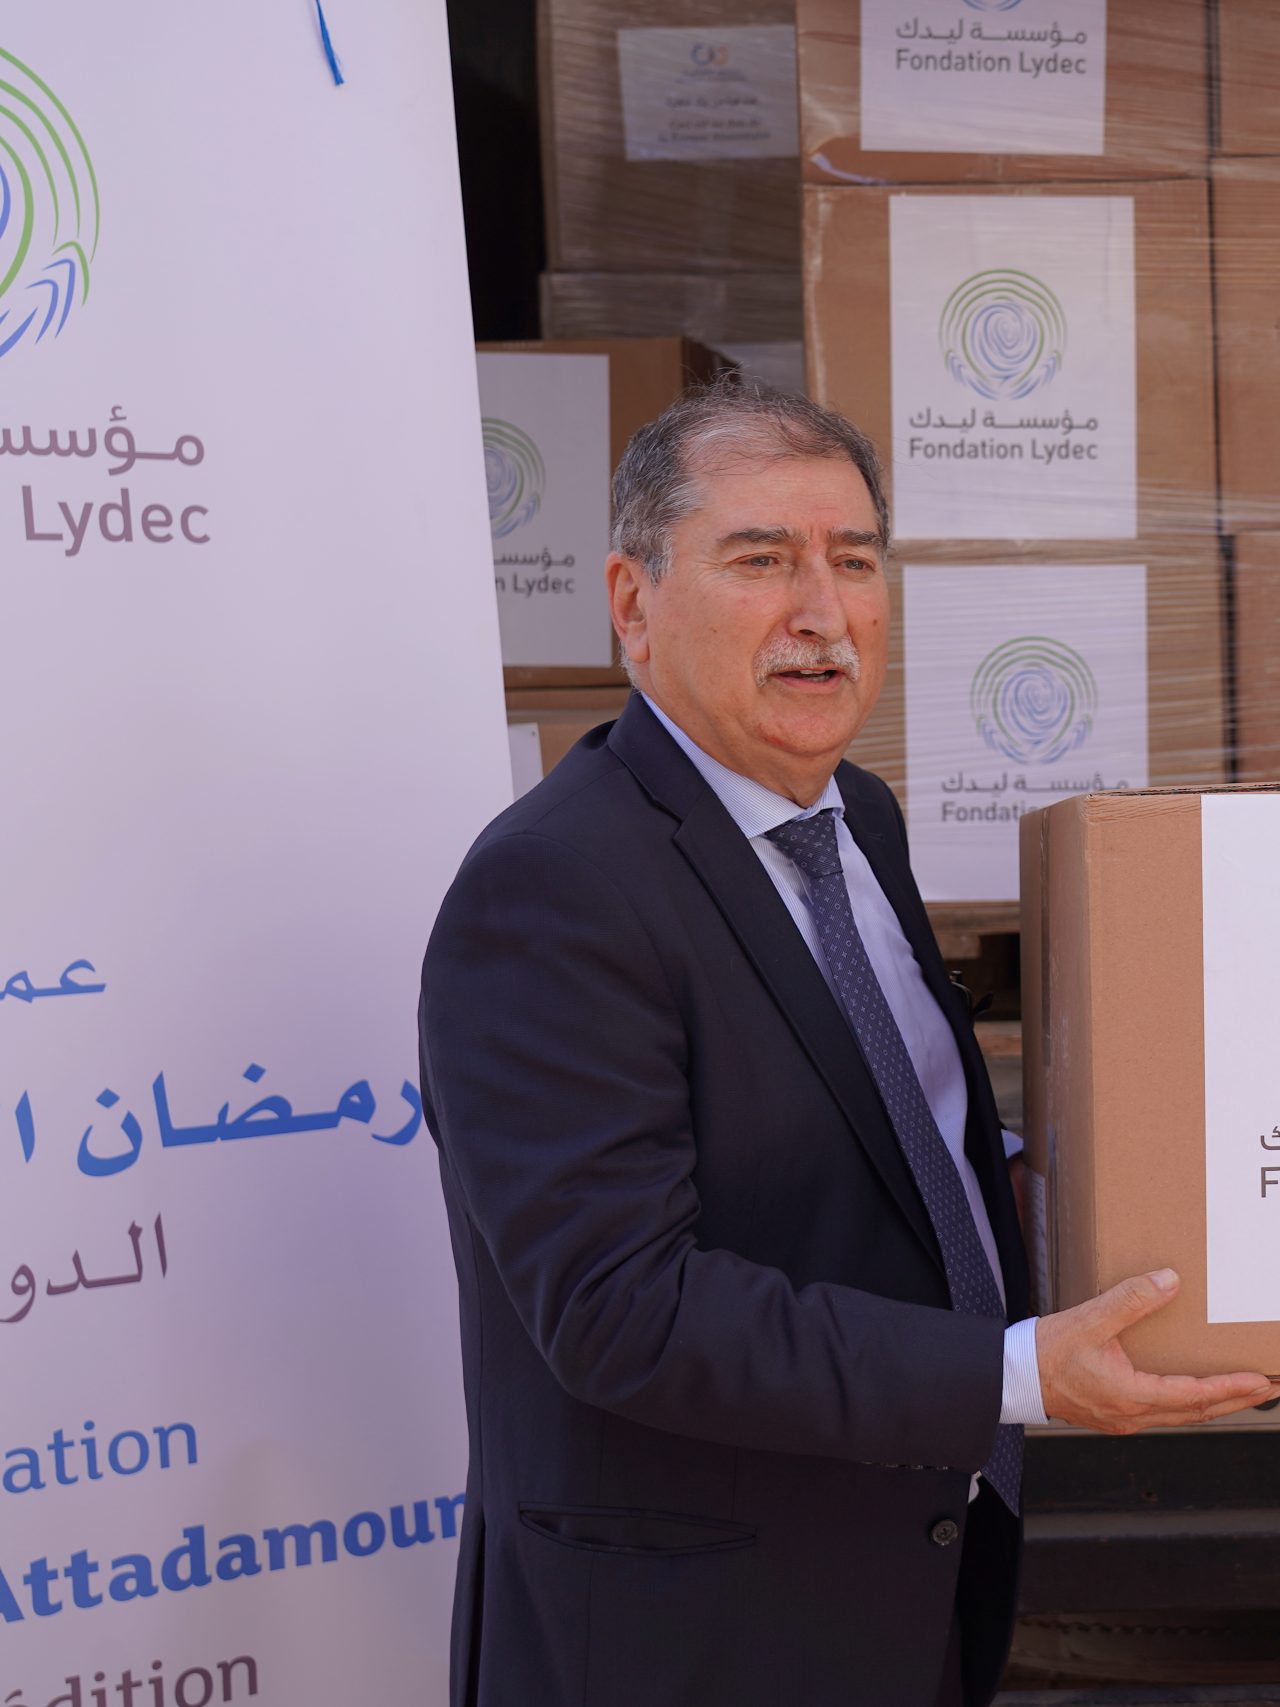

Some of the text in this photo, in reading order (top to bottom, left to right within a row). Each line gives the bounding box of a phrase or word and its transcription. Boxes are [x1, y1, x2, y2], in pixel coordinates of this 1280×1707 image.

[896, 17, 1088, 48] مؤسسة ليدك
[896, 48, 1087, 79] Fondation Lydec
[909, 407, 1098, 435] مؤسسة ليدك
[909, 437, 1099, 465] Fondation Lydec
[22, 485, 211, 557] Lydec
[494, 545, 575, 571] مؤسس
[513, 573, 575, 598] Lydec
[941, 772, 1008, 797] ليدك
[941, 801, 1038, 823] Fondati
[77, 1063, 422, 1177] رمضان
[2, 1420, 198, 1494] ation
[3, 1655, 258, 1707] dition
